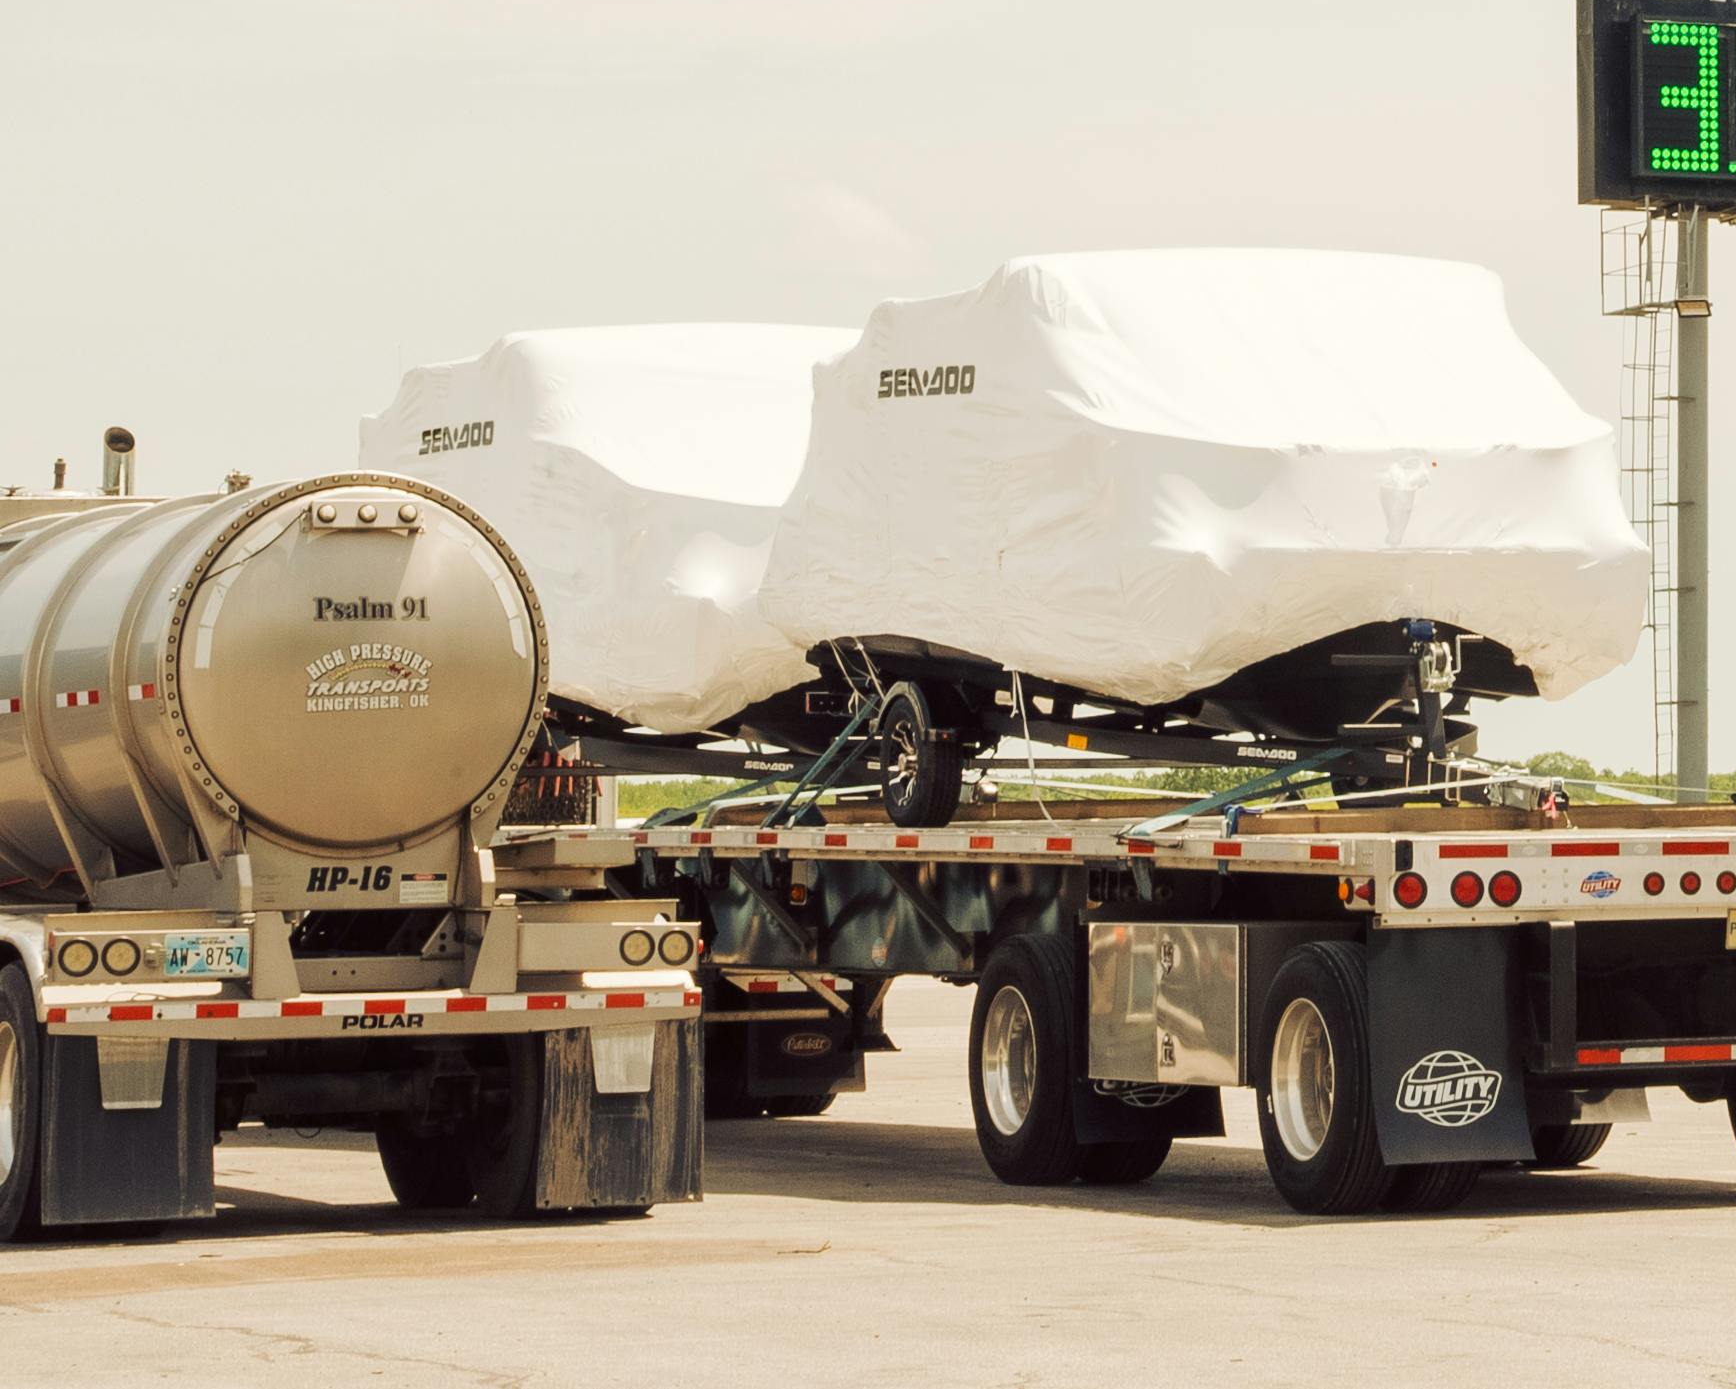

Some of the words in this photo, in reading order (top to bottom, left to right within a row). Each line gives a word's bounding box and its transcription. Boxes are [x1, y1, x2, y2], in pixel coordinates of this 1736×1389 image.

[313, 596, 396, 621] Psalm
[401, 596, 430, 621] 91
[305, 649, 346, 680] HIGH
[350, 643, 433, 676] PRESSURE
[307, 678, 429, 697] TRANSPORTS
[410, 695, 429, 708] OK
[306, 866, 393, 892] HP-16
[1582, 879, 1619, 892] UTILITY
[342, 1014, 424, 1029] POLAR
[1404, 1076, 1495, 1107] UTILITY
